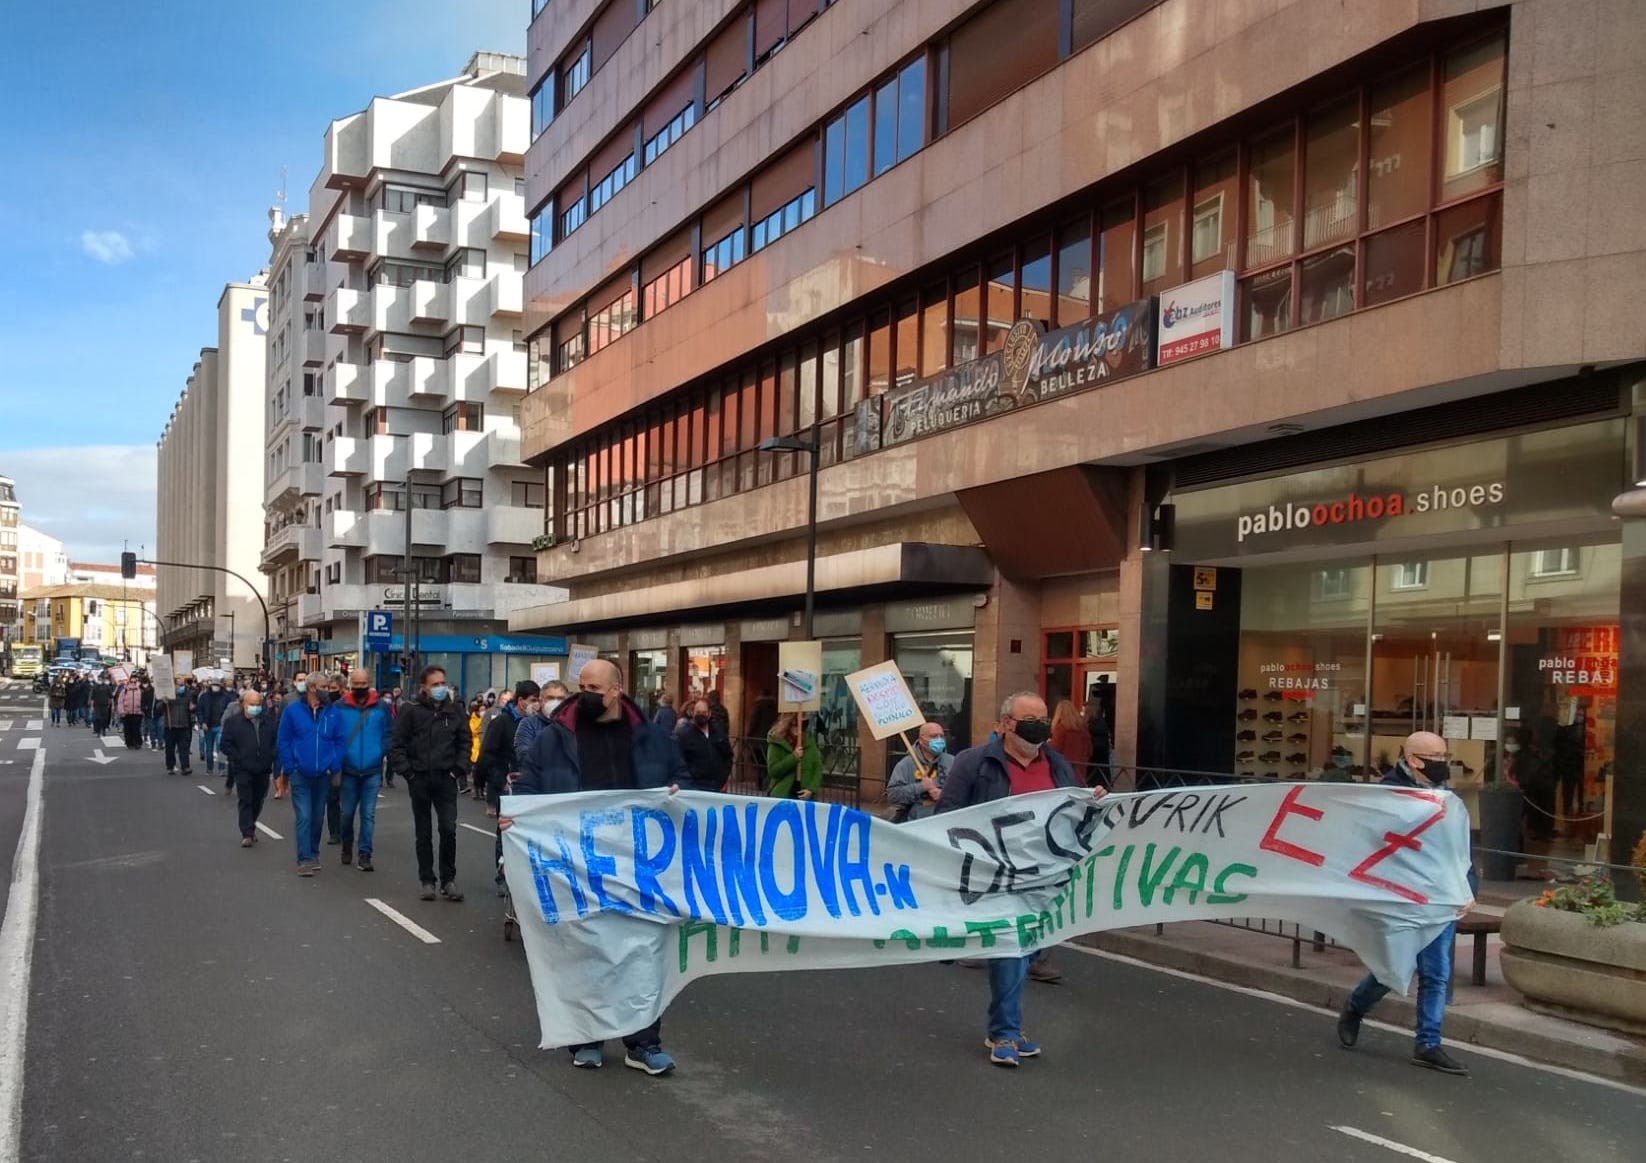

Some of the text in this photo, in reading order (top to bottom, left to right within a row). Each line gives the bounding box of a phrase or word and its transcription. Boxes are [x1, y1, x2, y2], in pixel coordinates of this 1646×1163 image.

[1190, 299, 1221, 315] Auditores
[1175, 343, 1188, 356] 945
[1189, 340, 1199, 352] 27
[1211, 334, 1220, 346] 10
[1041, 361, 1107, 395] BELLEZA
[910, 402, 981, 434] PELUQUERIA
[1269, 676, 1329, 690] REBAJAS
